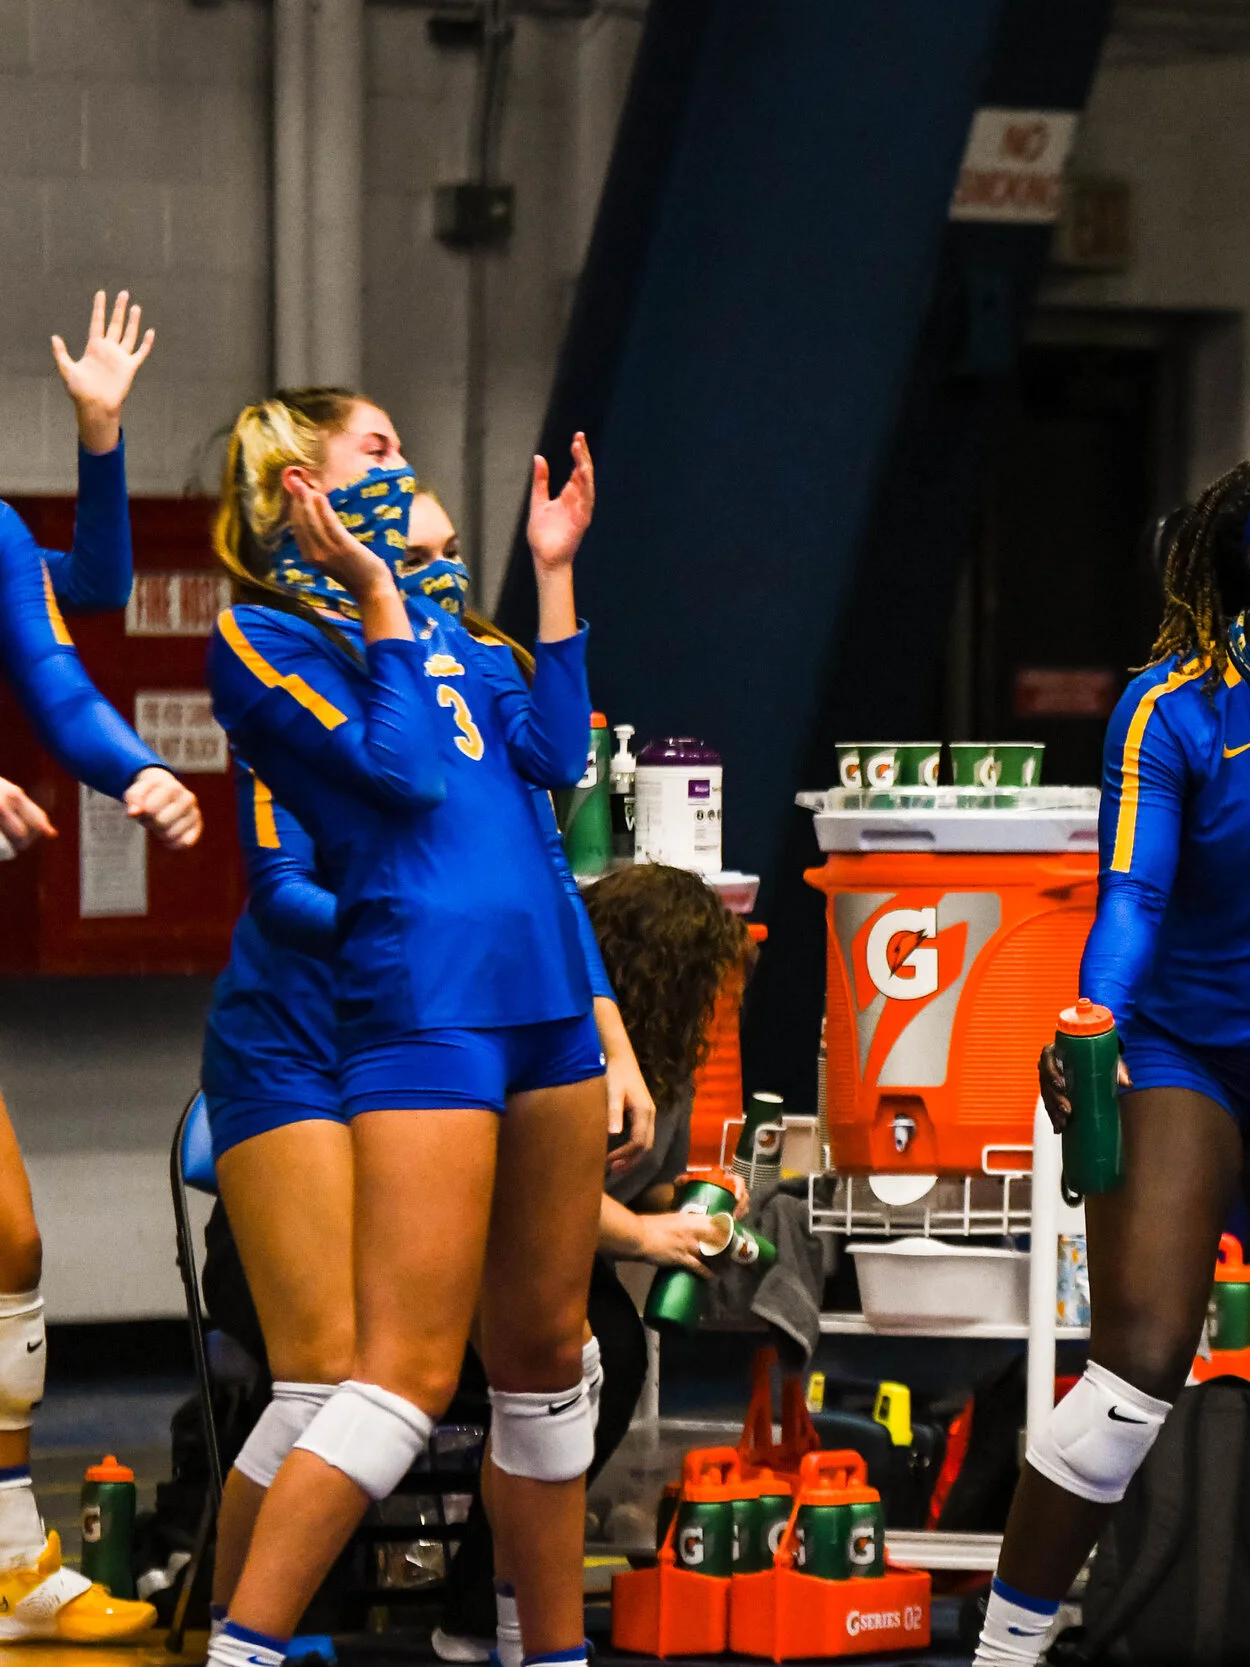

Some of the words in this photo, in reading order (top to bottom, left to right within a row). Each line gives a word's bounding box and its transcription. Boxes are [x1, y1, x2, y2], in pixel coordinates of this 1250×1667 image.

[1000, 122, 1049, 162] NO
[437, 684, 485, 761] 3
[840, 756, 862, 788] G
[866, 755, 895, 788] G
[866, 907, 938, 1000] G
[680, 1527, 704, 1565] G
[850, 1527, 875, 1566] G
[904, 1606, 922, 1631] 02
